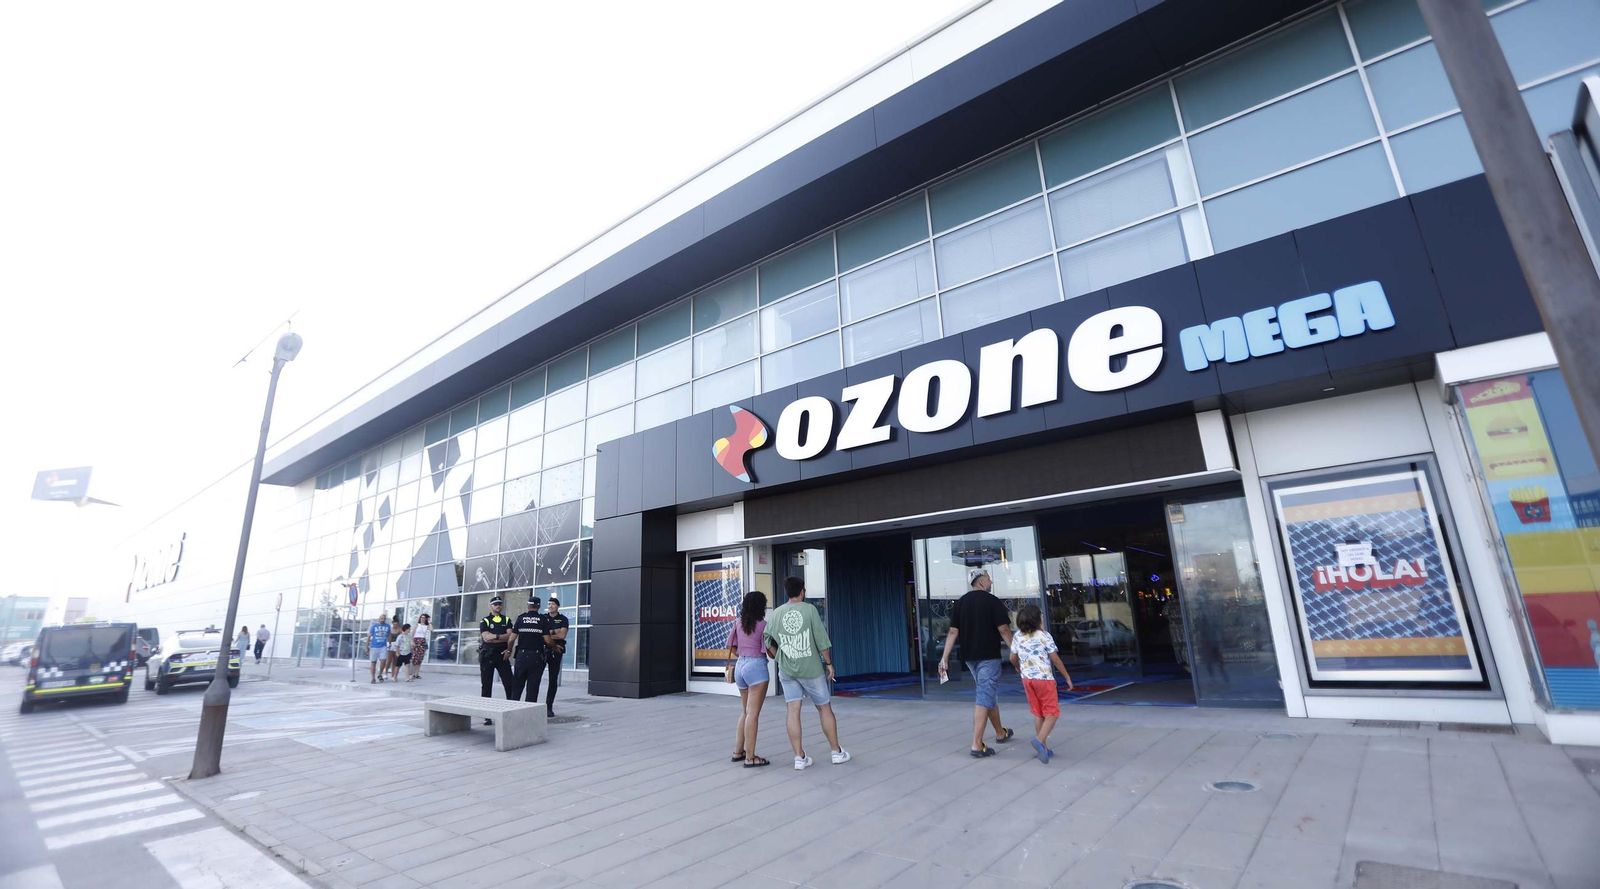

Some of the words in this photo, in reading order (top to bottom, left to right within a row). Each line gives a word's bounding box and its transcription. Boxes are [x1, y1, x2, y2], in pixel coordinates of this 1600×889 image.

[775, 305, 1164, 461] ozone
[1179, 280, 1396, 372] MEGA
[701, 605, 737, 618] ¡HOLA!
